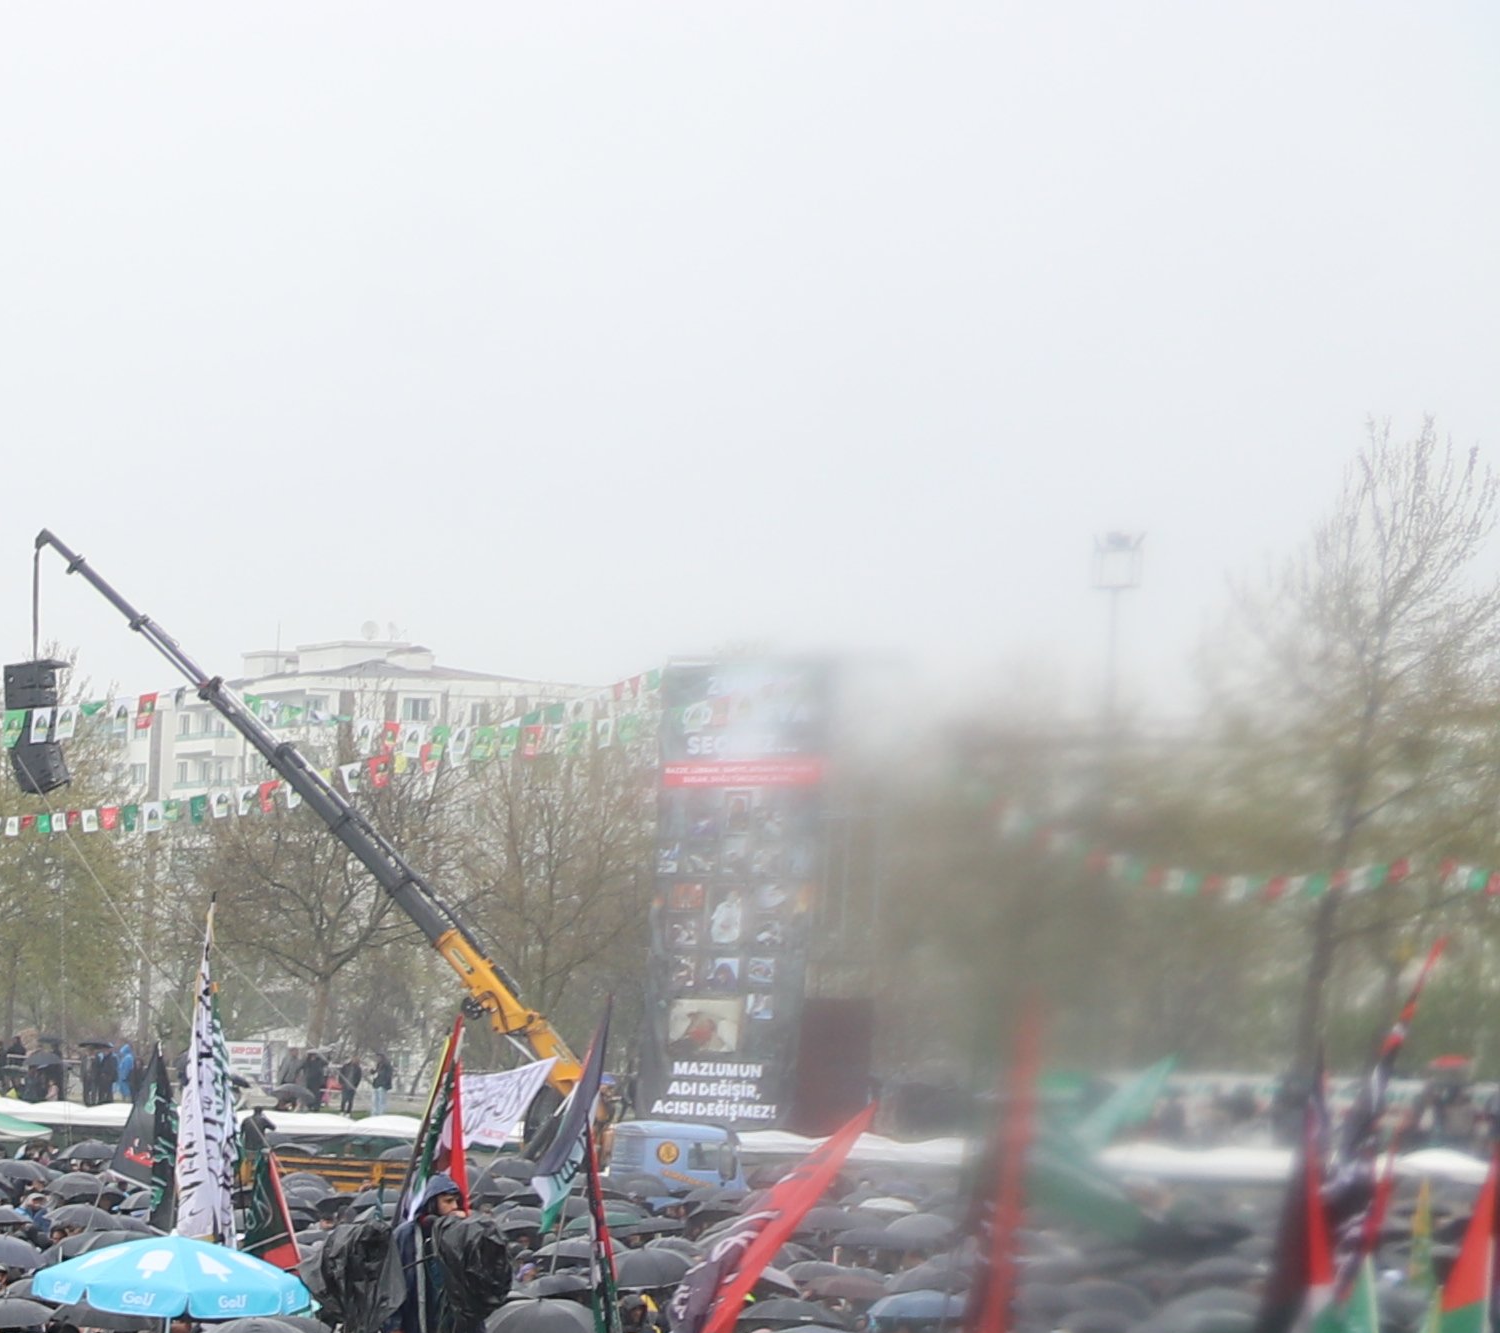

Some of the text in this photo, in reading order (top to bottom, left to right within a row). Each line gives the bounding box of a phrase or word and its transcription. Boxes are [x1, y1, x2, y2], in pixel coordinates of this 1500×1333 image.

[672, 1061, 763, 1079] MAZLUMUN
[668, 1079, 762, 1100] ADI DEĞİŞİR,
[651, 1098, 777, 1120] ACISI DEĞİŞMEZ!
[122, 1290, 157, 1307] Golf
[218, 1294, 248, 1308] Golf
